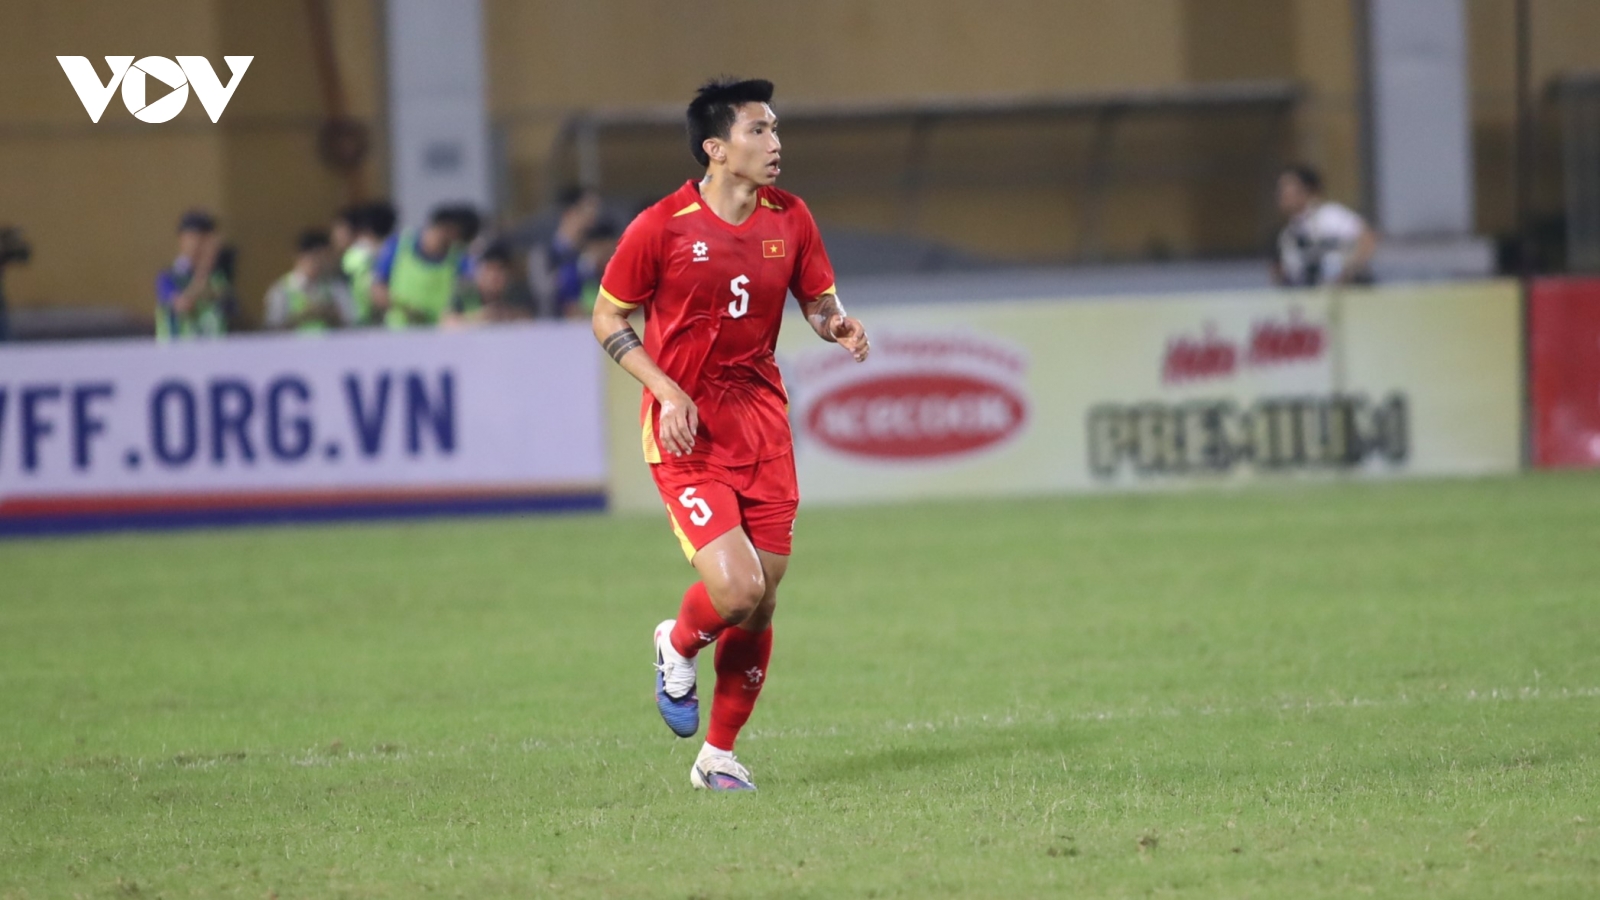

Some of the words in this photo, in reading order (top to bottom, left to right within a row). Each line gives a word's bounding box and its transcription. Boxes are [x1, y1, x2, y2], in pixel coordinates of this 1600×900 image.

[728, 274, 750, 319] 5
[0, 369, 457, 472] FF.ORG.VN
[678, 487, 713, 527] 5
